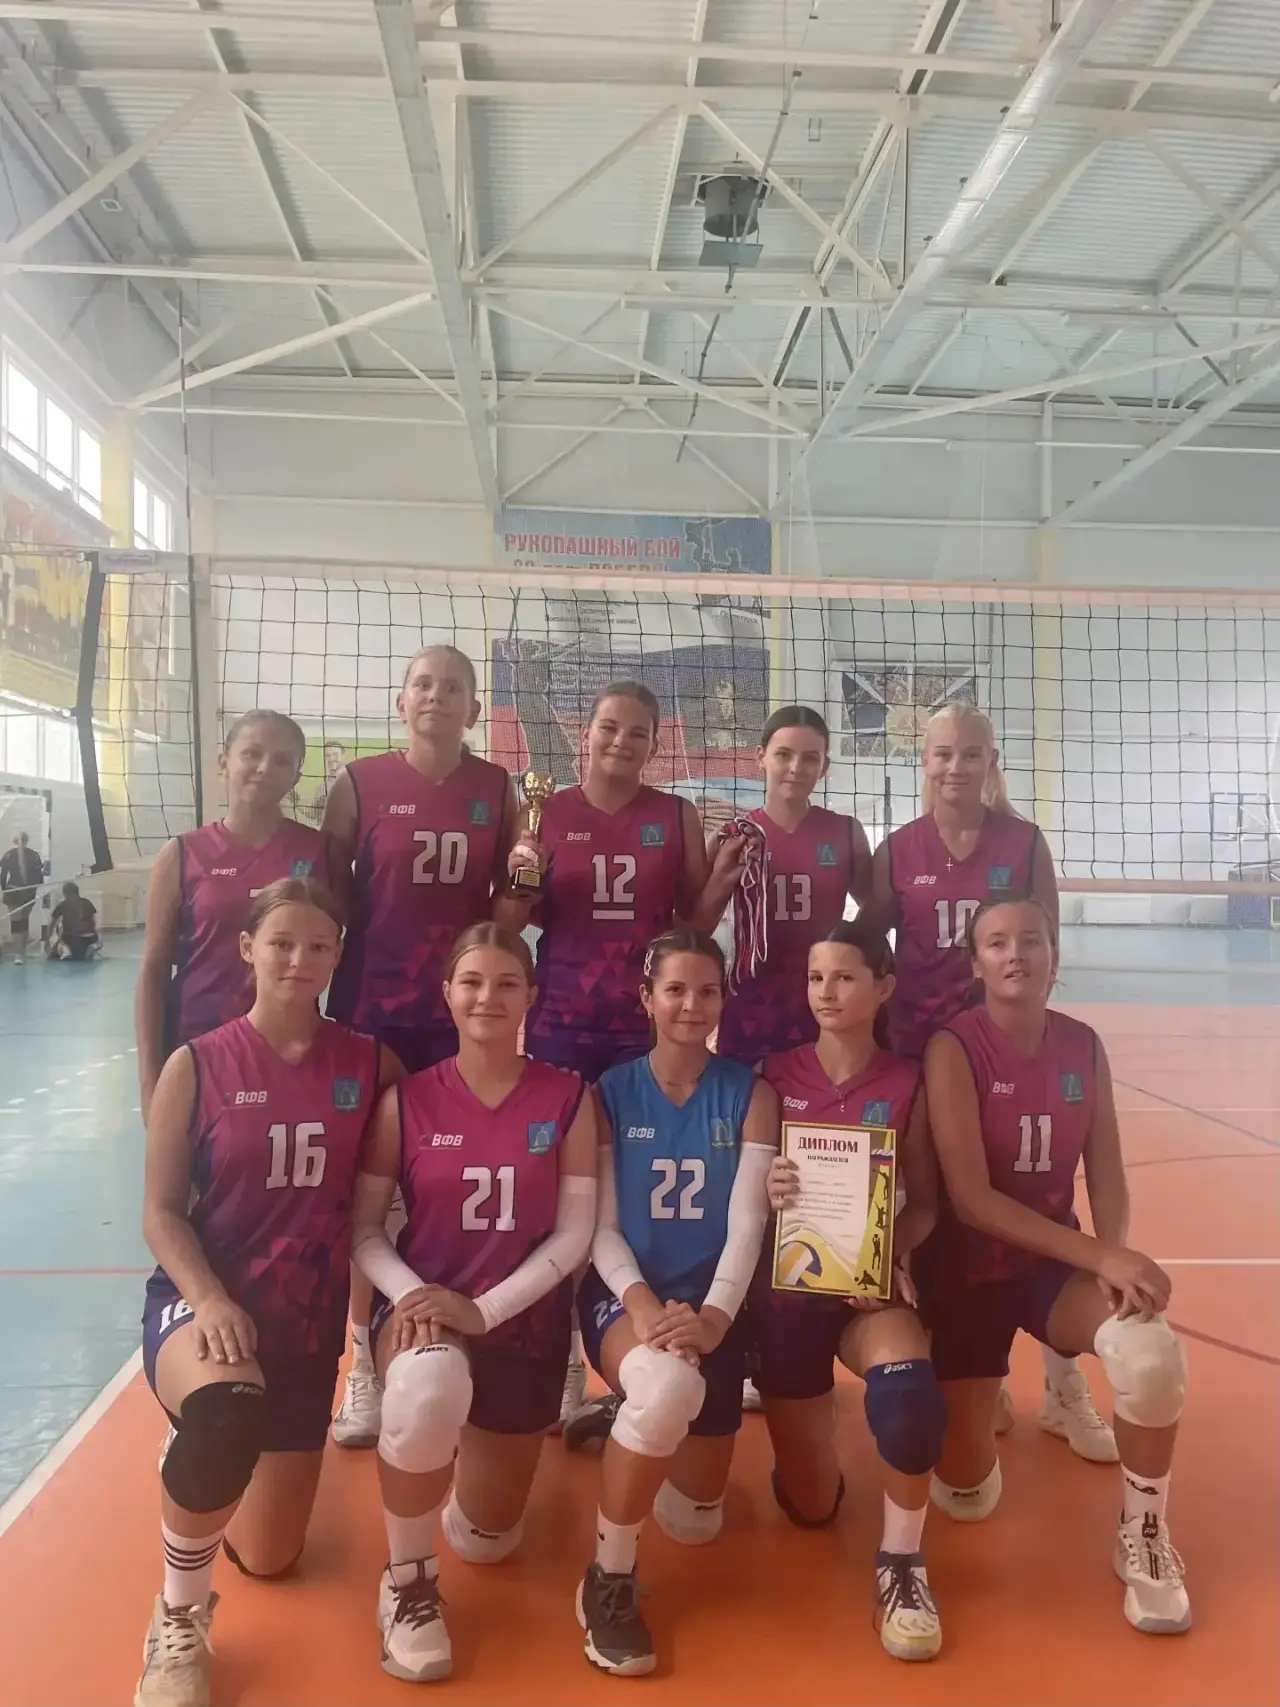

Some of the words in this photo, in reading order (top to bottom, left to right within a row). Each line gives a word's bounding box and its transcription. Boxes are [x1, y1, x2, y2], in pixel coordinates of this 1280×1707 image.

[504, 533, 638, 557] РУКОПАШНЫЙ
[644, 537, 681, 559] БОЙ
[389, 804, 416, 815] ВФВ
[566, 832, 591, 841] ВФВ
[412, 830, 469, 884] 20
[591, 854, 636, 903] 12
[913, 875, 937, 885] ВФВ
[773, 874, 812, 921] 13
[235, 1090, 268, 1104] ВФВ
[783, 1096, 809, 1111] ВФВ
[431, 1133, 464, 1147] ВФВ
[627, 1126, 656, 1139] ВФВ
[1013, 1114, 1052, 1172] 11
[797, 1136, 858, 1153] ДИПЛОМ
[265, 1121, 327, 1190] 16
[461, 1165, 516, 1231] 21
[650, 1158, 705, 1220] 22
